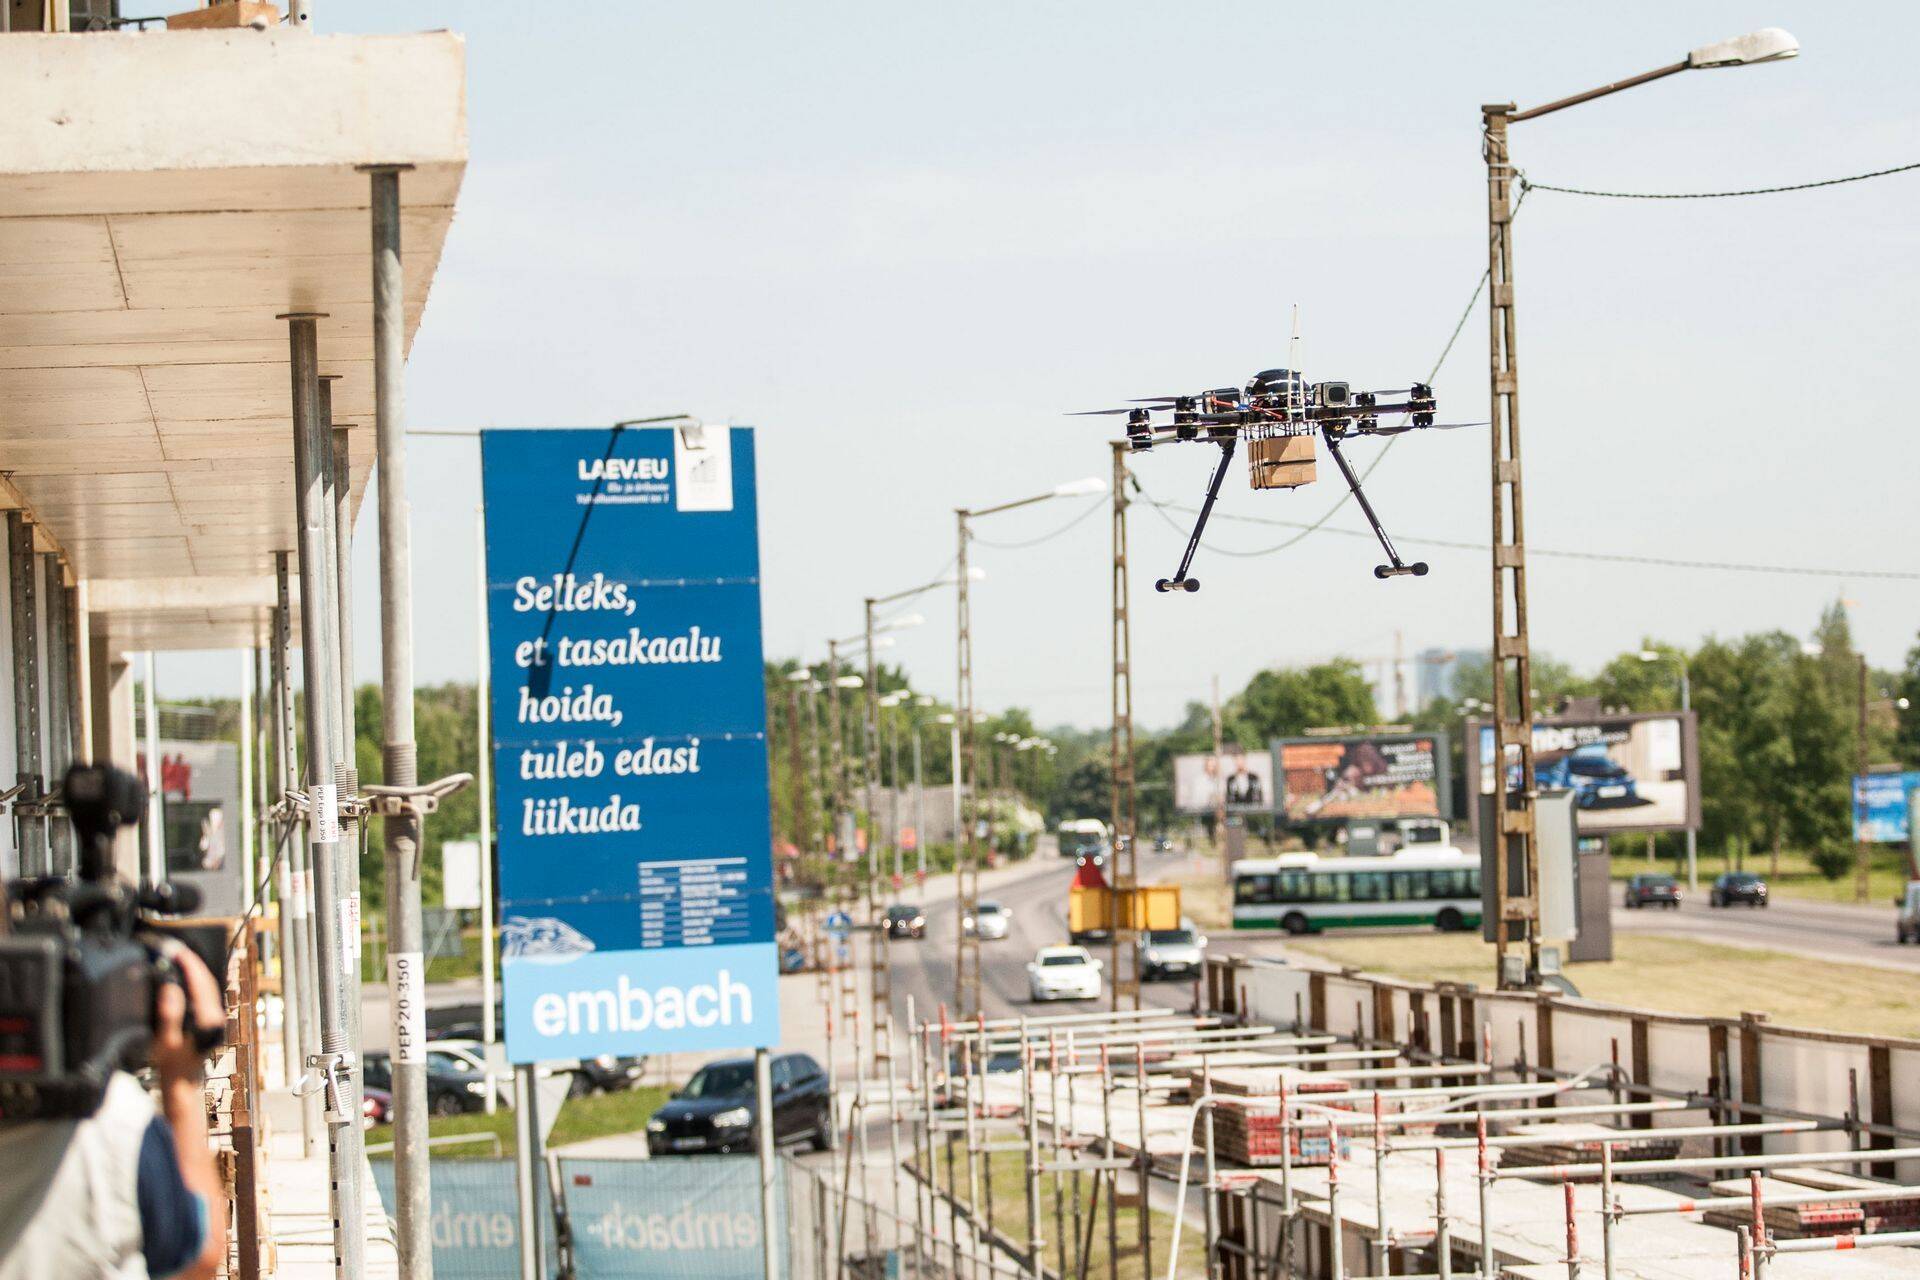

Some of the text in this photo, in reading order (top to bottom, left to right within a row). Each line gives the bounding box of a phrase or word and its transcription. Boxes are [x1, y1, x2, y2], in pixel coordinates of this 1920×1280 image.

[578, 457, 669, 480] LAEV.EU
[513, 572, 637, 616] Selleks,
[515, 625, 722, 668] et tasakaalu
[518, 684, 623, 727] hoida,
[520, 737, 701, 780] tuleb edasi
[522, 794, 642, 836] liikuda
[532, 968, 753, 1038] embach
[399, 1025, 411, 1060] PEP
